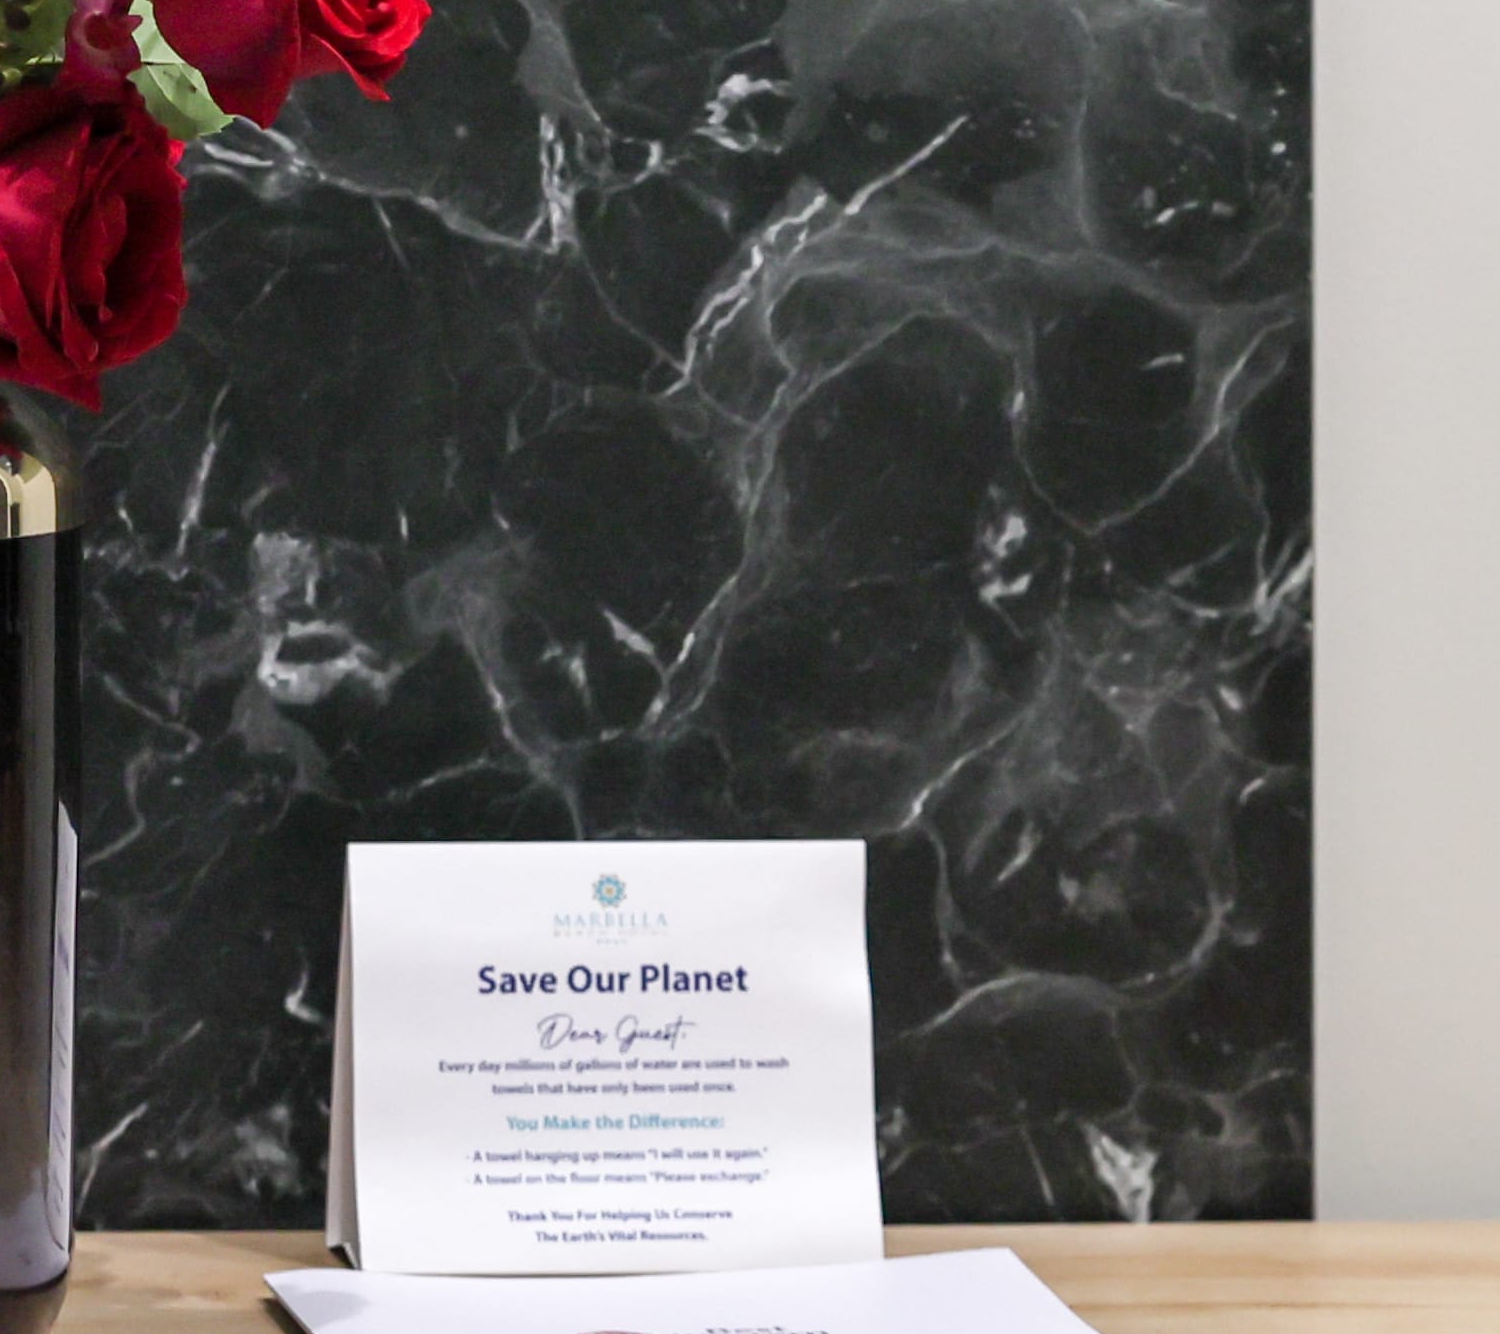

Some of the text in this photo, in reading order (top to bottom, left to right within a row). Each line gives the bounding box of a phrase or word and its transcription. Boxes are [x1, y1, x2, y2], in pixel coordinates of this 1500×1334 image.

[553, 912, 668, 928] MARBELLA
[478, 964, 747, 994] Save Our Planet
[537, 1013, 607, 1050] Dear
[438, 1060, 475, 1073] Every
[478, 1060, 501, 1074] day
[559, 1058, 572, 1070] of
[625, 1058, 638, 1069] of
[705, 1058, 736, 1068] used
[739, 1058, 752, 1068] to
[537, 1082, 563, 1094] that
[567, 1082, 598, 1094] have
[669, 1081, 700, 1093] used
[506, 1115, 538, 1131] You
[543, 1115, 589, 1130] Make
[595, 1115, 624, 1129] the
[473, 1150, 483, 1162] A
[486, 1149, 523, 1162] towel
[473, 1173, 483, 1185] A
[486, 1173, 523, 1184] towel
[508, 1210, 547, 1222] Thank
[551, 1210, 574, 1221] You
[577, 1209, 598, 1220] For
[601, 1209, 651, 1223] Helping
[535, 1230, 558, 1242] The
[608, 1229, 637, 1241] Vital
